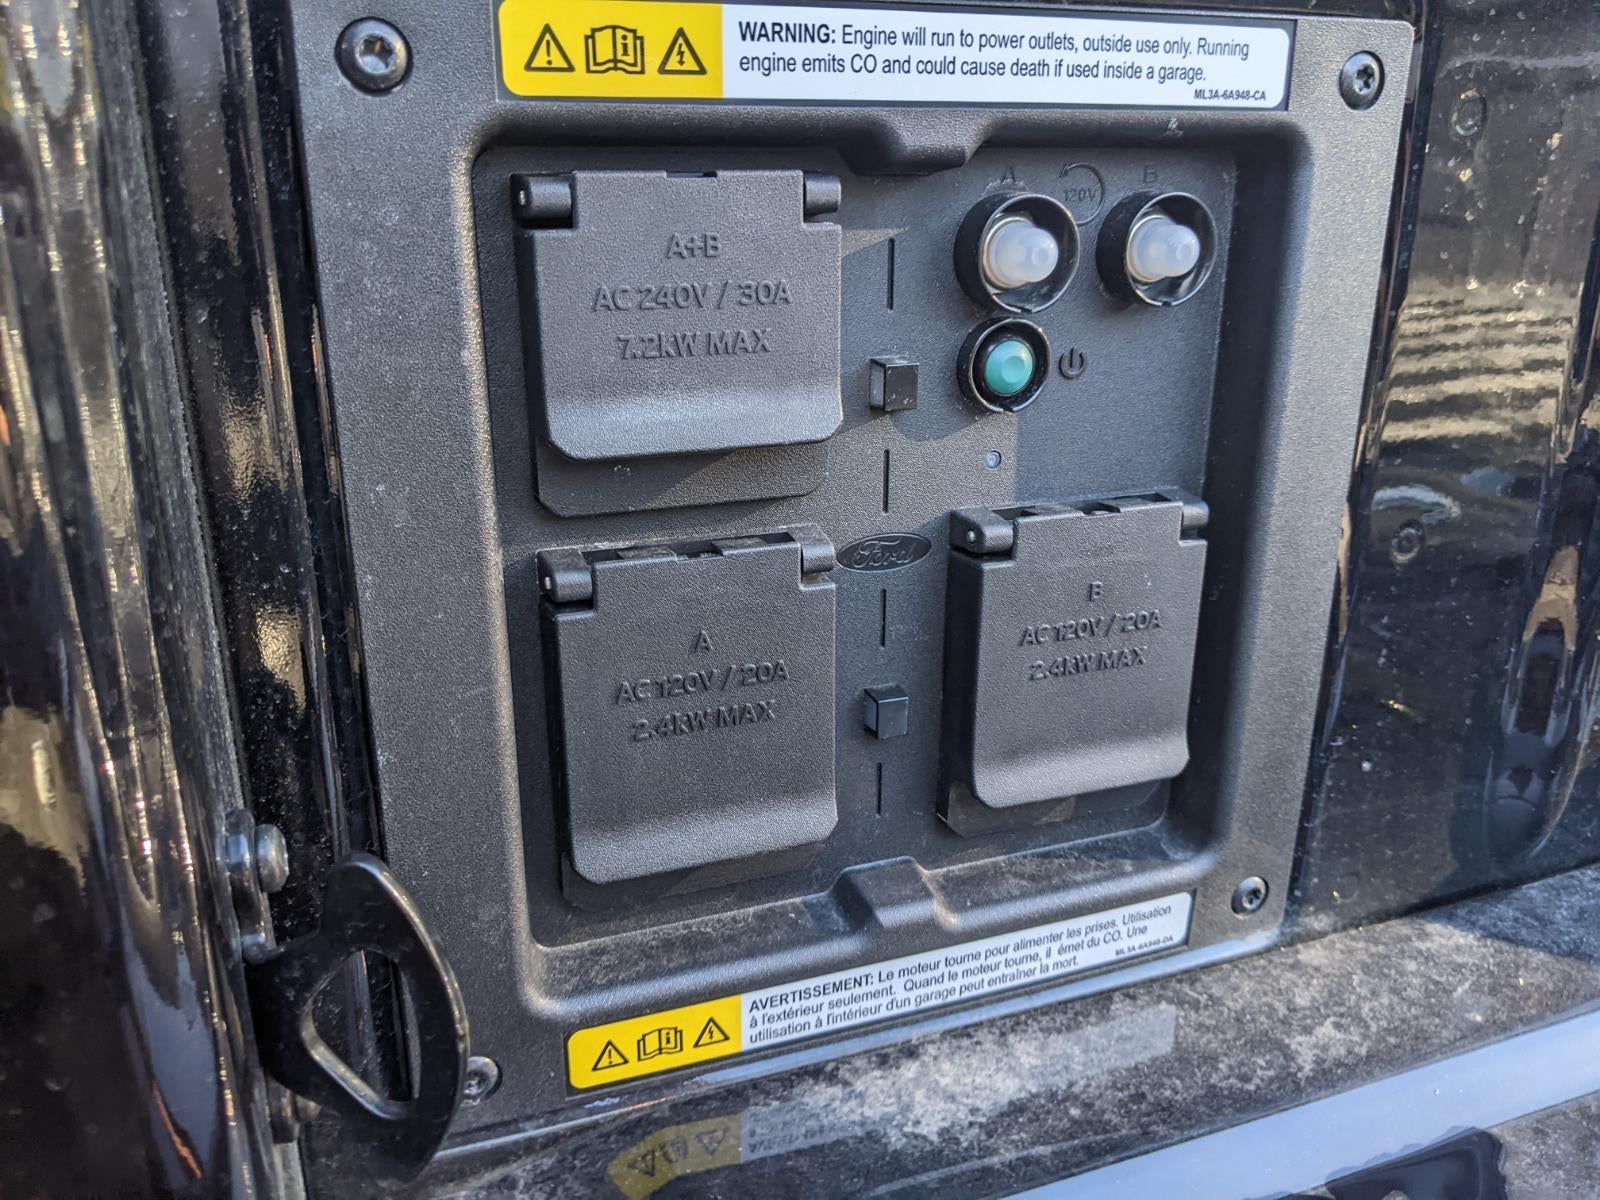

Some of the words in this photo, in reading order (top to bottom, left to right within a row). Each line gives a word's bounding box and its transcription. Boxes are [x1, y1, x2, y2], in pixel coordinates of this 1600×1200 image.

[739, 21, 836, 44] WARNING:
[842, 24, 897, 49] Engine
[902, 27, 926, 46] will
[931, 31, 955, 47] run
[960, 29, 973, 47] to
[979, 32, 1025, 52] power
[1029, 32, 1078, 54] outlets,
[1083, 34, 1131, 53] outside
[1136, 39, 1159, 53] use
[1163, 37, 1192, 59] only.
[1197, 37, 1250, 61] Running
[740, 53, 797, 76] engine
[802, 53, 845, 73] emits
[850, 53, 877, 73] CO
[882, 55, 911, 74] and
[916, 56, 956, 75] could
[961, 60, 1006, 76] cause
[1011, 58, 1050, 78] death
[1054, 59, 1064, 77] if
[1066, 60, 1099, 79] used
[1103, 60, 1142, 80] inside
[1146, 66, 1154, 80] a
[1158, 66, 1207, 85] garage.
[1193, 88, 1267, 102] ML3A-6A948-CA
[1001, 165, 1016, 183] A
[1142, 165, 1159, 183] B
[1063, 188, 1097, 202] 120V
[666, 231, 722, 259] A+B
[592, 285, 630, 312] AC
[639, 281, 711, 310] 240V
[717, 279, 732, 310] /
[737, 279, 791, 306] 30A
[707, 328, 770, 356] MAX
[852, 538, 917, 568] Ford
[694, 630, 714, 653] A
[1018, 624, 1050, 647] AC
[1053, 615, 1104, 642] 120V
[1121, 609, 1161, 633] 20A
[1098, 645, 1148, 671] MAX
[616, 678, 651, 705] AC
[655, 668, 718, 698] 120V
[721, 664, 737, 691] /
[741, 658, 790, 687] 20A
[717, 698, 775, 729] MAX
[749, 972, 874, 1013] AVERTISSEMENT:
[878, 969, 895, 983] Le
[898, 960, 941, 978] moteur
[944, 949, 981, 968] tourne
[984, 944, 1010, 963] pour
[1013, 931, 1065, 953] alimenter
[1066, 926, 1082, 939] les
[1084, 918, 1119, 939] prises.
[1122, 904, 1172, 926] Utilisation
[749, 1015, 758, 1028] à
[762, 1001, 824, 1026] l'extérieur
[828, 985, 896, 1010] seulement.
[903, 970, 945, 993] Quand
[948, 968, 959, 982] le
[961, 960, 1001, 979] moteur
[1045, 947, 1052, 959] il
[1057, 940, 1085, 956] émet
[1087, 935, 1101, 949] du
[1103, 929, 1123, 945] CO.
[1126, 925, 1148, 939] Une
[749, 1018, 811, 1044] utilisation
[814, 1016, 823, 1029] à
[826, 1001, 881, 1026] l'intérieur
[886, 996, 911, 1011] d'un
[914, 986, 956, 1008] garage
[958, 977, 985, 997] peut
[987, 965, 1036, 987] entraîner
[1039, 961, 1049, 975] la
[1052, 955, 1080, 972] mort.
